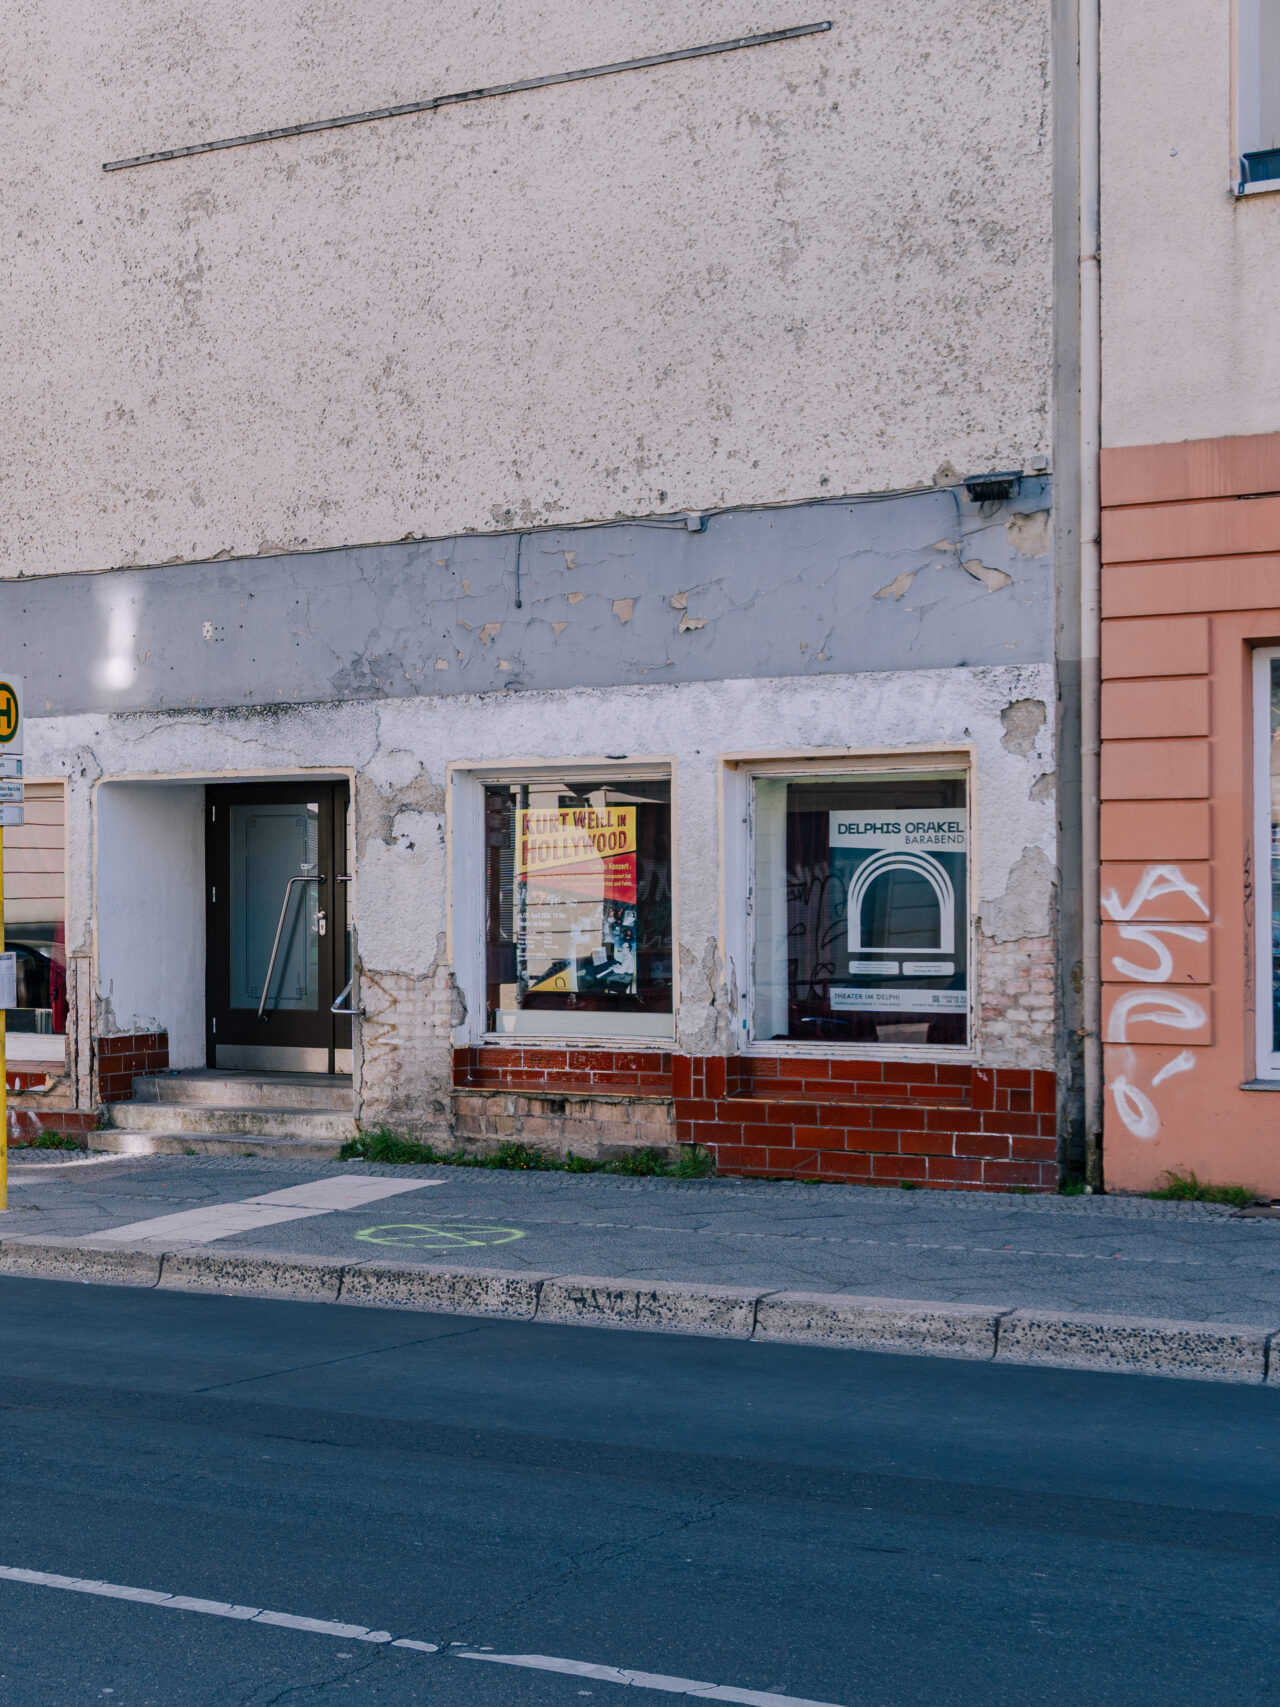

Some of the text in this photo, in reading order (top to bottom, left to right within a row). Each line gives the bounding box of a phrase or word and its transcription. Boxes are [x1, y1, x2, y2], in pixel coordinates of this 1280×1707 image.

[522, 810, 627, 836] KURT WEILL IN
[837, 821, 965, 835] DELPHIS ORAKEL
[522, 830, 627, 866] HOLLYWOOD
[905, 834, 965, 844] BARABEND
